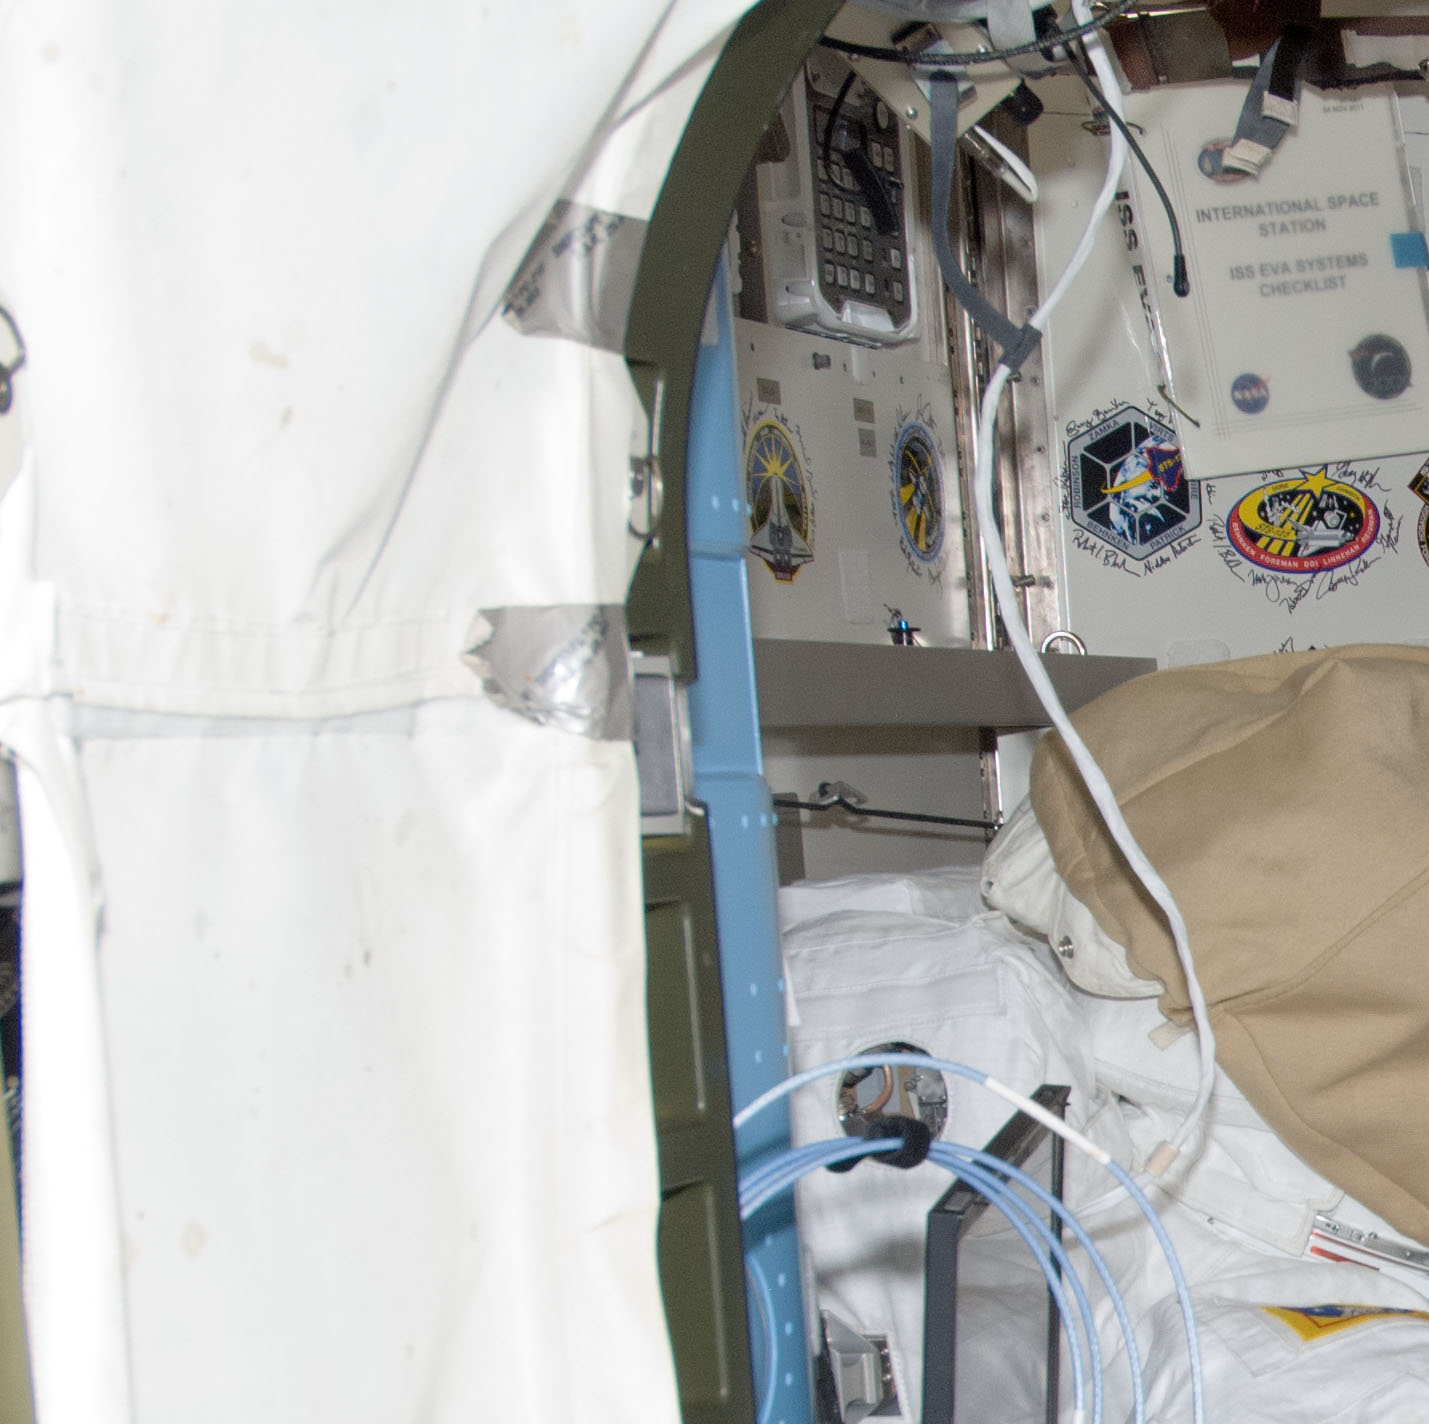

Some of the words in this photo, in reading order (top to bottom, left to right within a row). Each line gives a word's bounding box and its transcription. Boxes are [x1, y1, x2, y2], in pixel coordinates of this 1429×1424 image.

[1196, 197, 1324, 224] INTERNATIONAL
[1327, 191, 1381, 211] SPACE
[1115, 191, 1139, 252] ISS
[1258, 217, 1327, 238] STATION
[1229, 264, 1256, 281] ISS
[1259, 261, 1292, 278] EVA
[1295, 251, 1370, 274] SYSTEMS
[1258, 275, 1348, 298] CHECKLIST
[1088, 419, 1121, 442] ZAMKA
[1149, 421, 1176, 443] VIRTS
[1071, 454, 1082, 510] ROBINSON
[1086, 520, 1131, 551] BEHNKEN
[1149, 524, 1187, 551] PATRICK
[1260, 553, 1299, 568] FOREMAN
